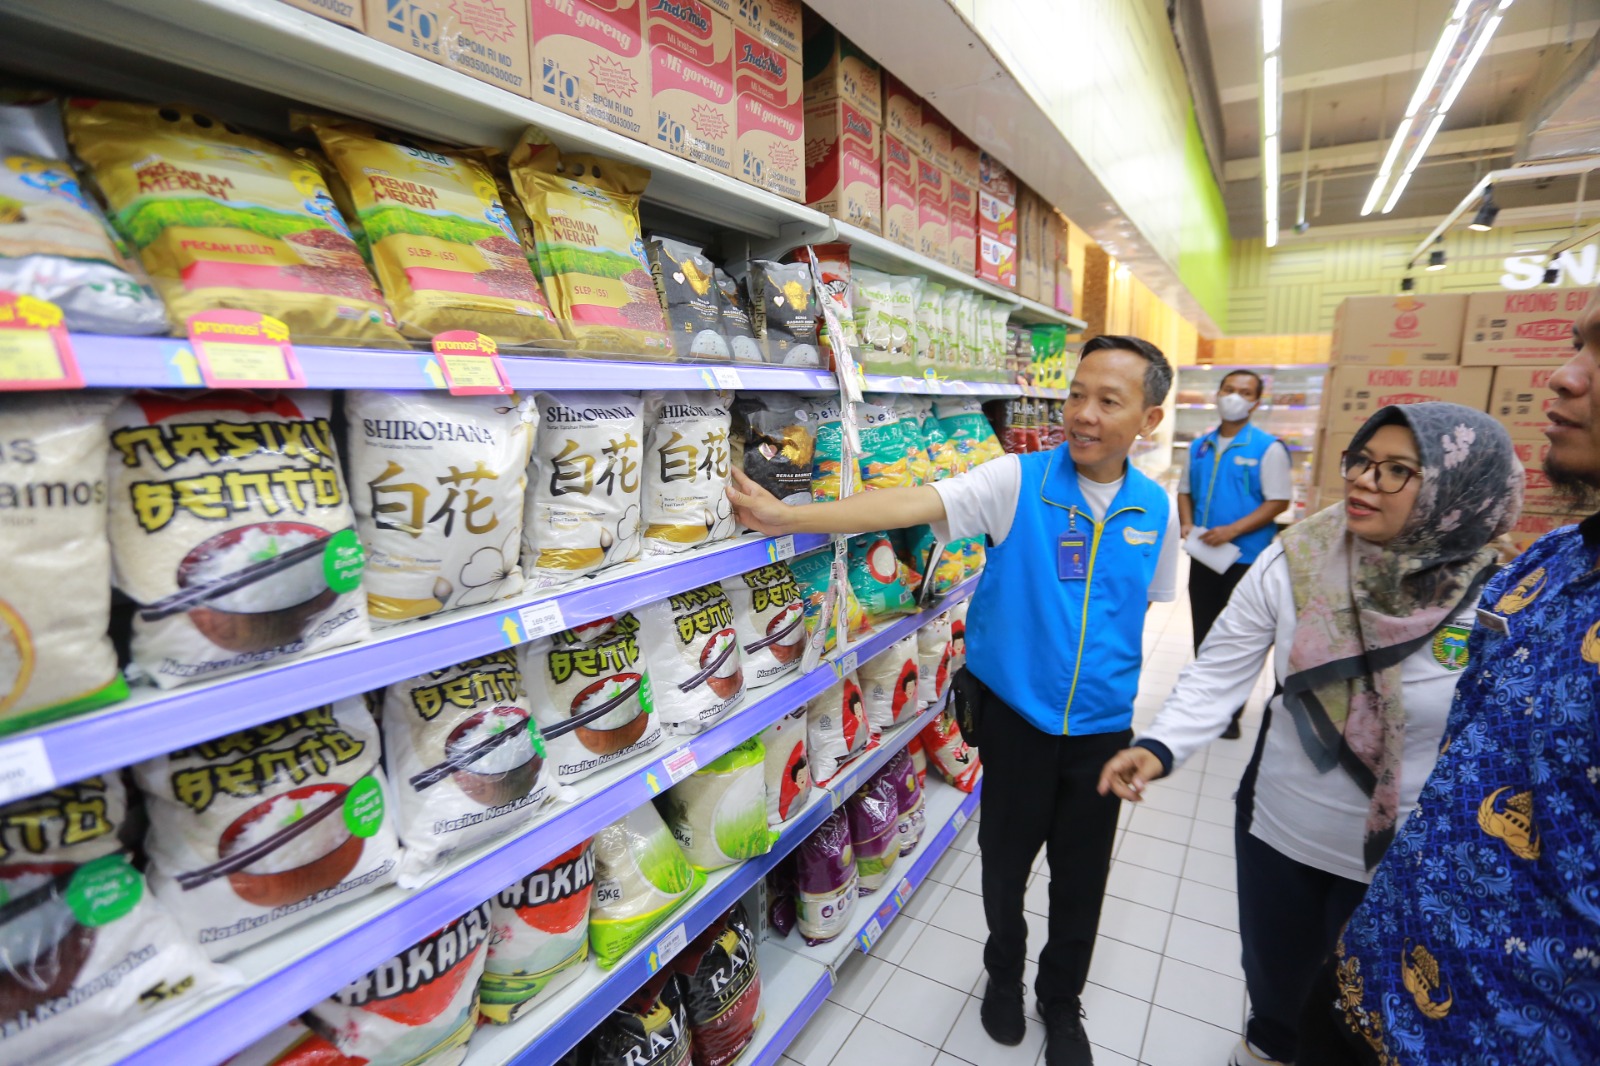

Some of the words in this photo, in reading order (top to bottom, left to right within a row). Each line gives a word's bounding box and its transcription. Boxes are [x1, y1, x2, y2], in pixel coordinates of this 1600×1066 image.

[575, 10, 632, 50] goreng
[457, 34, 486, 56] BPOM
[498, 52, 513, 67] MD
[543, 63, 579, 104] 40
[661, 53, 682, 74] Mi
[683, 64, 725, 98] goreng
[658, 115, 686, 146] 40
[745, 98, 762, 117] Mi
[762, 109, 796, 135] goreng
[368, 175, 439, 199] PREMIUM
[374, 189, 437, 210] MERAH
[550, 216, 599, 235] PREMIUM
[553, 229, 597, 247] MERAH
[407, 247, 432, 258] SLEP
[1500, 243, 1600, 291] SN
[574, 285, 592, 295] SLEP
[1504, 292, 1558, 313] KHONG
[194, 321, 260, 335] promosi
[1515, 323, 1573, 337] MERA
[435, 339, 478, 352] promosi
[1367, 369, 1413, 387] KHONG
[1418, 369, 1459, 387] GUAN
[363, 418, 496, 446] SHIROHANA
[549, 432, 639, 497] 白花
[657, 427, 729, 484] 白花
[0, 481, 106, 508] amos
[131, 466, 343, 534] BENTO
[366, 460, 499, 539] 白花
[699, 703, 724, 720] Nasiku
[172, 729, 366, 814] BENTO
[559, 758, 597, 775] Nasiku
[598, 748, 621, 764] Nasi
[432, 813, 483, 836] Nasiku
[485, 802, 513, 821] Nasi
[513, 786, 547, 811] Keluar
[200, 916, 270, 944] Nasiku
[271, 893, 314, 921] Nasi
[315, 859, 396, 903] Keluargak
[716, 999, 744, 1026] BERAS
[621, 1002, 687, 1066] RAJA
